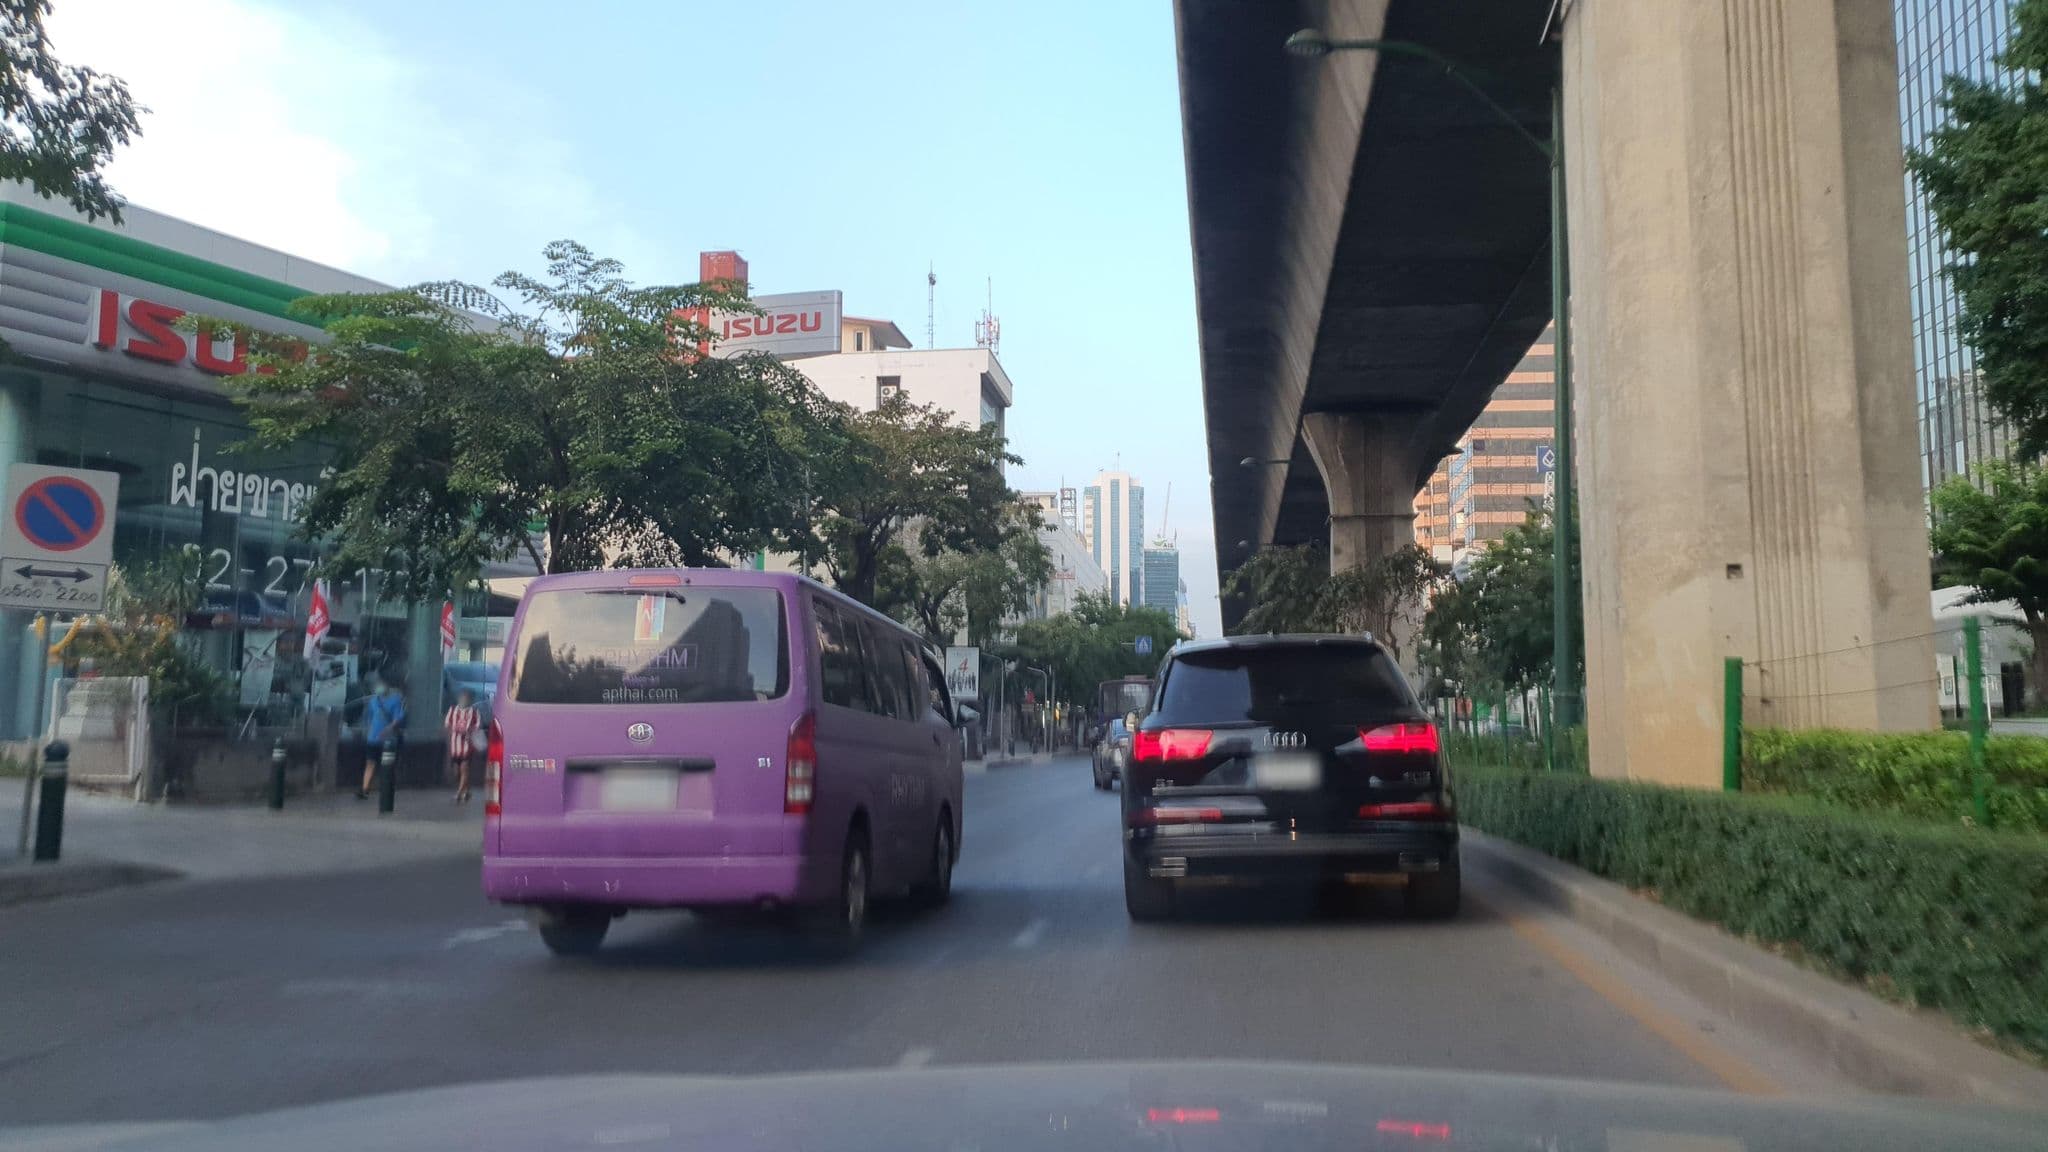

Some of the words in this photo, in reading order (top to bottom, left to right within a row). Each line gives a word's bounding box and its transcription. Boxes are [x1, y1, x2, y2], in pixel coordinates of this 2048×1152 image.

[723, 311, 822, 340] ISUZU
[98, 288, 350, 402] ISU
[602, 686, 679, 704] apthai.com
